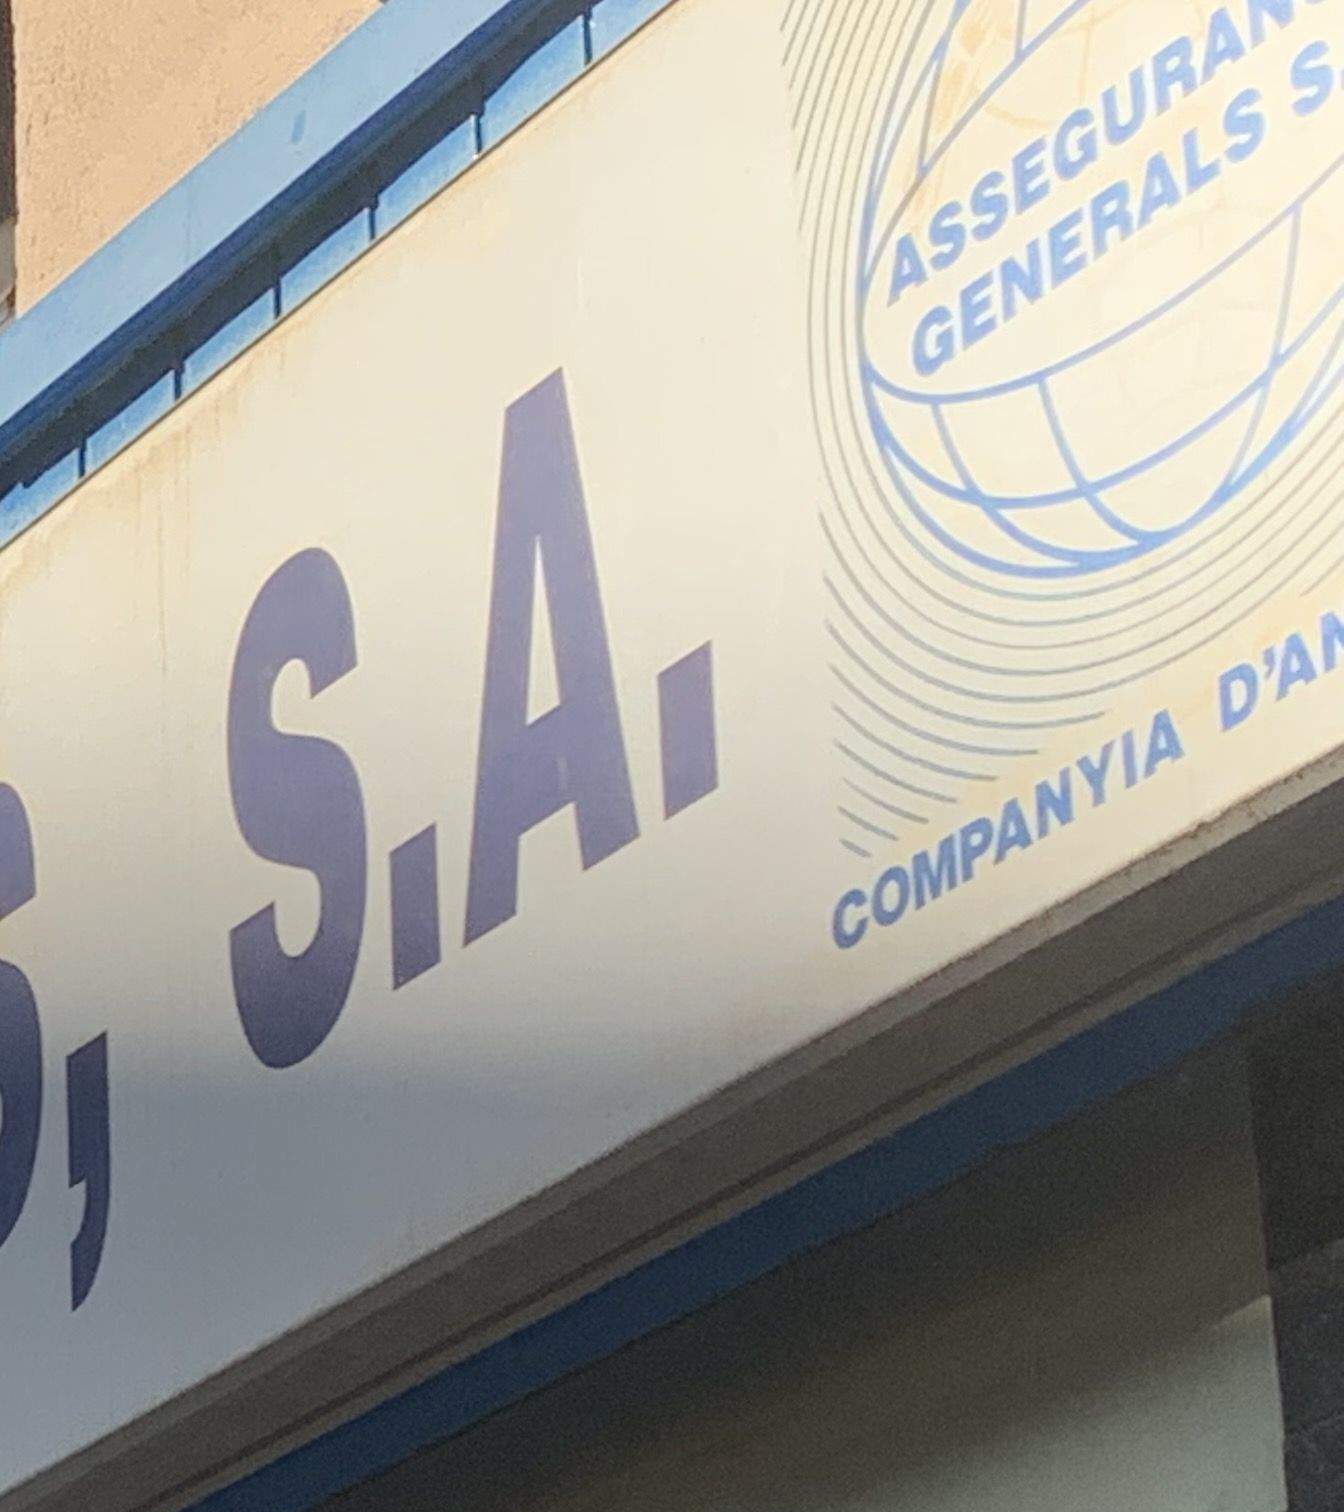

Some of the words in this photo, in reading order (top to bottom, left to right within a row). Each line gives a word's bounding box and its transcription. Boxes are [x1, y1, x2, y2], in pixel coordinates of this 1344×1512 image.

[885, 0, 1327, 305] ASSEGURAN
[912, 88, 1265, 377] GENERALS
[226, 366, 719, 1069] S.A.
[831, 707, 1184, 951] COMPANYIA
